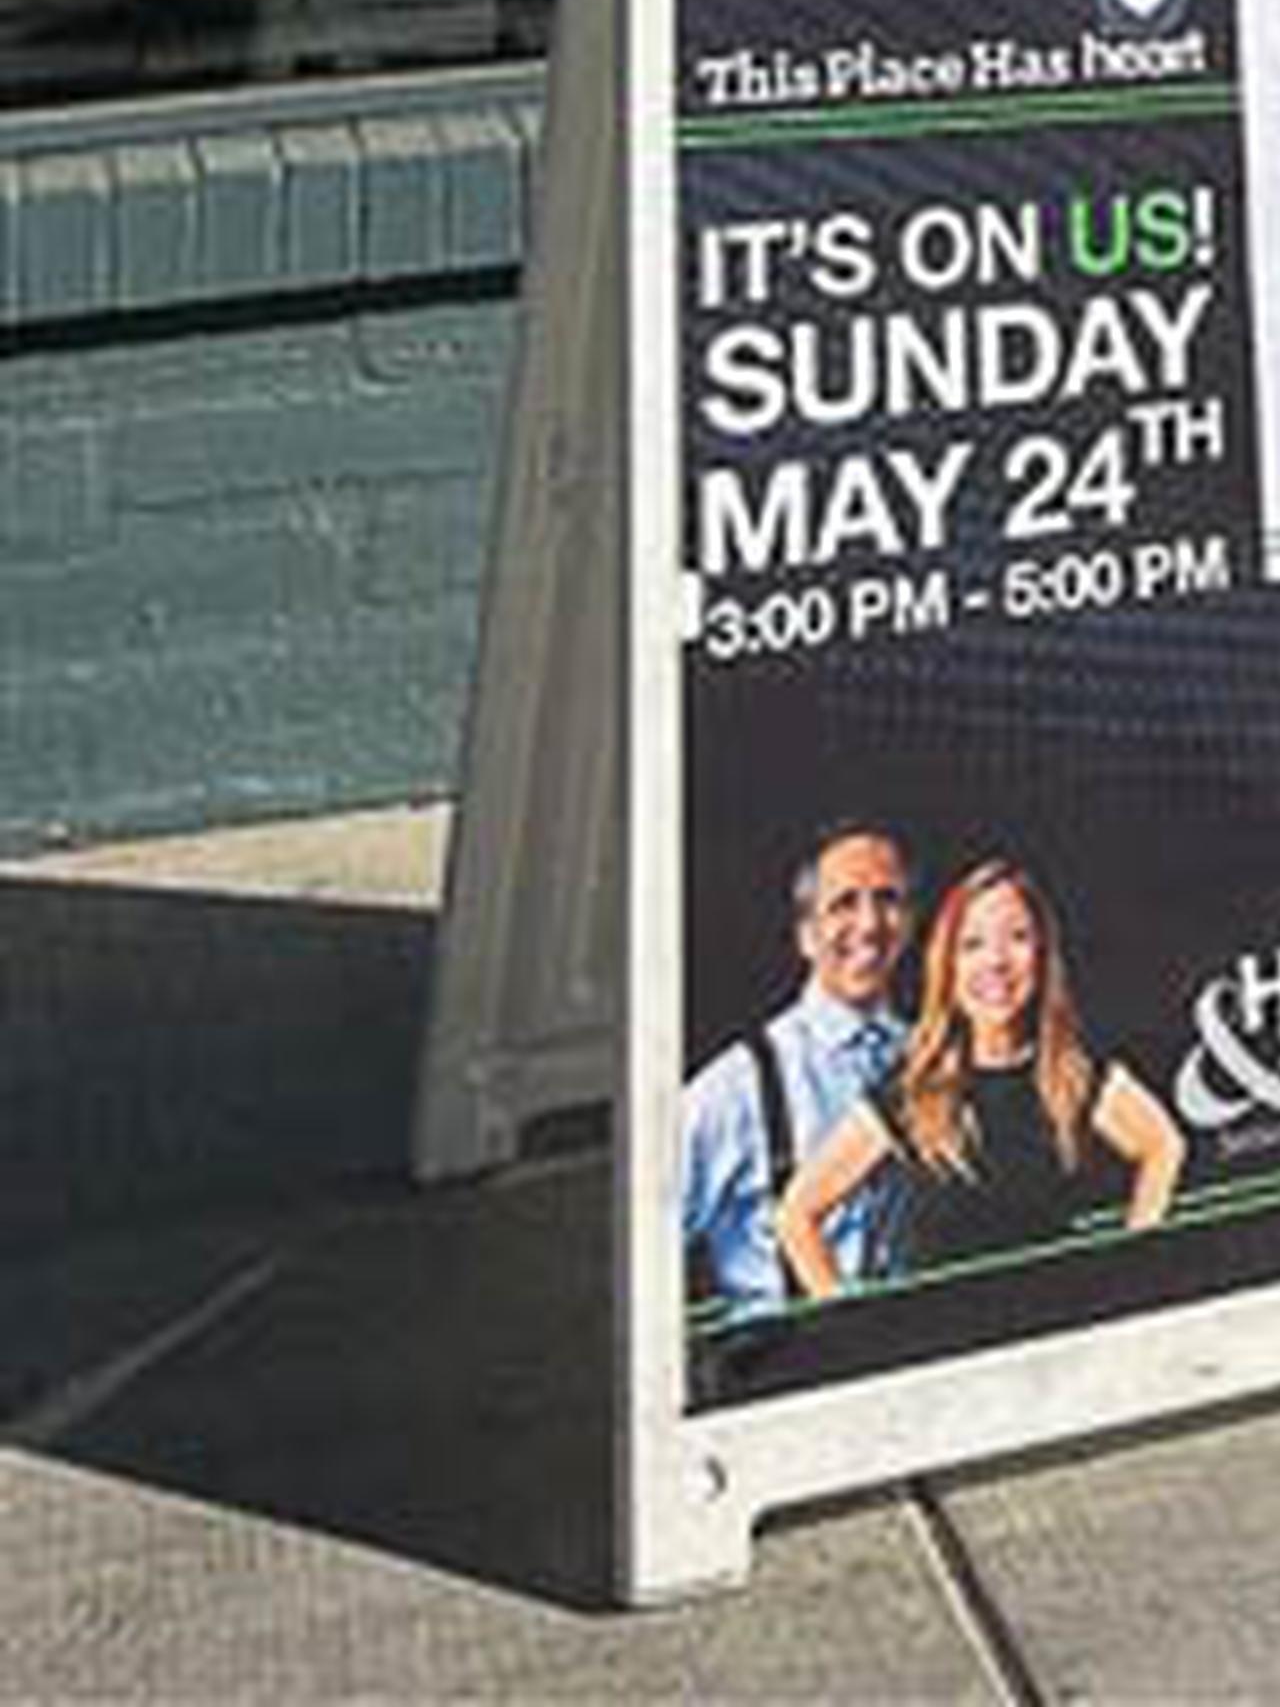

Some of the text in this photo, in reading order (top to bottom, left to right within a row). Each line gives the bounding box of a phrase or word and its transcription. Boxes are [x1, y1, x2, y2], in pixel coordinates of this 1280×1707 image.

[697, 50, 820, 104] This
[824, 41, 966, 95] Place
[971, 39, 1072, 88] Has
[903, 203, 1039, 289] ON
[1069, 187, 1214, 275] US!
[701, 286, 1213, 434] SUNDAY
[702, 442, 974, 575] MAY
[706, 535, 1231, 658] 3:00 PM - 5:00 PM
